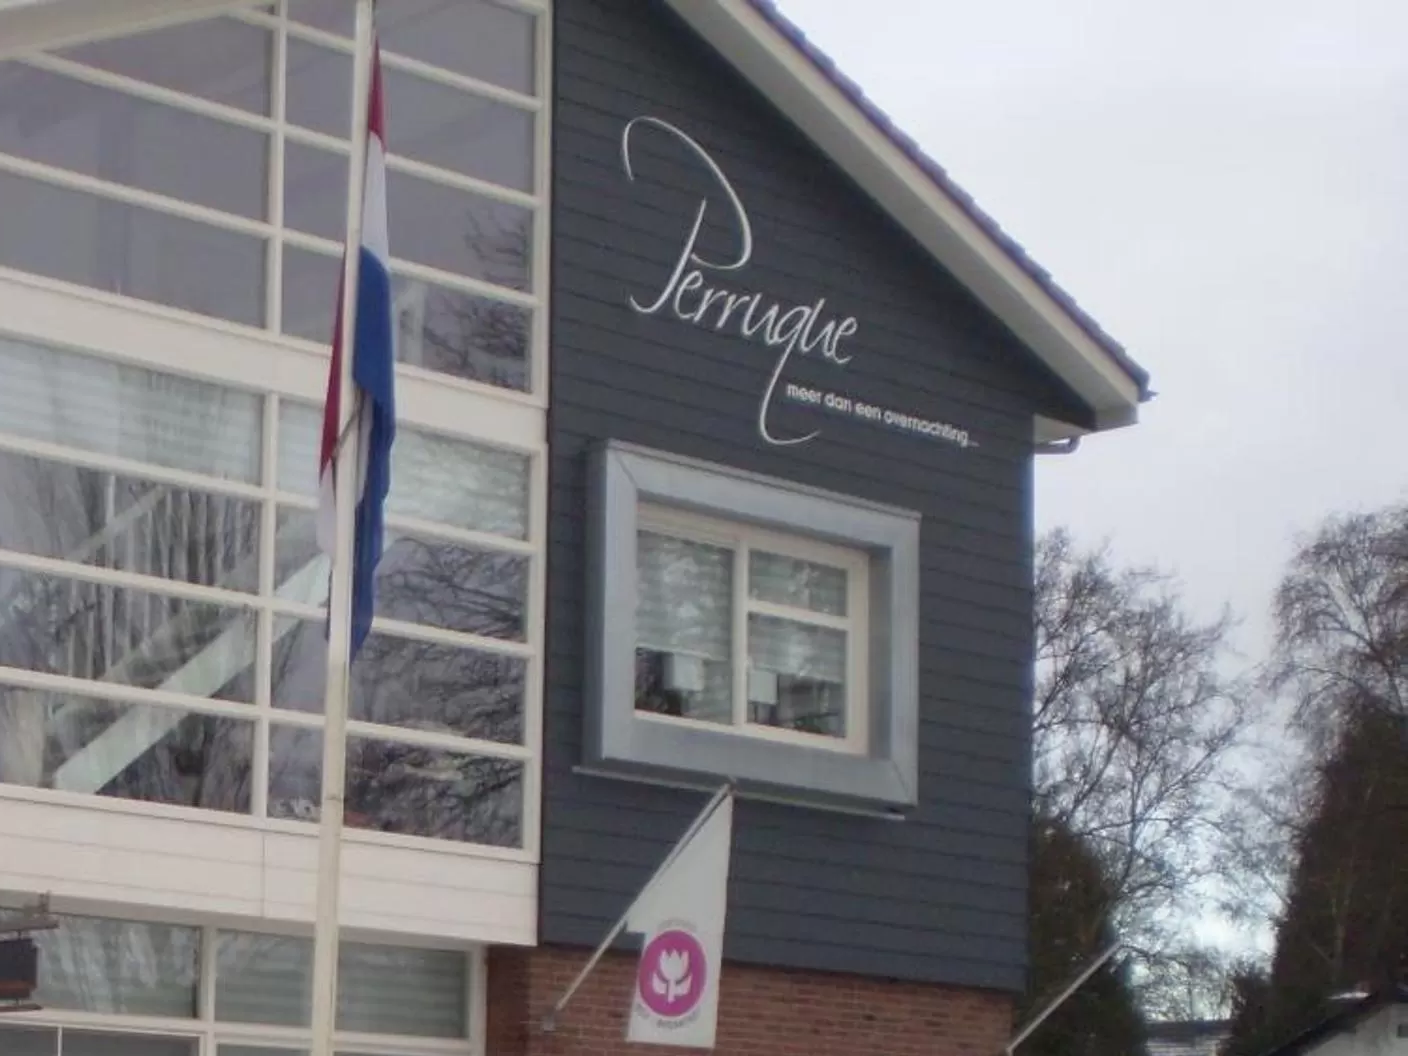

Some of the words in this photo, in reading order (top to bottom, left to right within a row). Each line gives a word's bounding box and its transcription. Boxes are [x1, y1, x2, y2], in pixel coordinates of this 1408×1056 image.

[622, 115, 858, 446] Perruque
[786, 383, 822, 404] meer
[823, 392, 853, 413] dan
[855, 402, 882, 421] een
